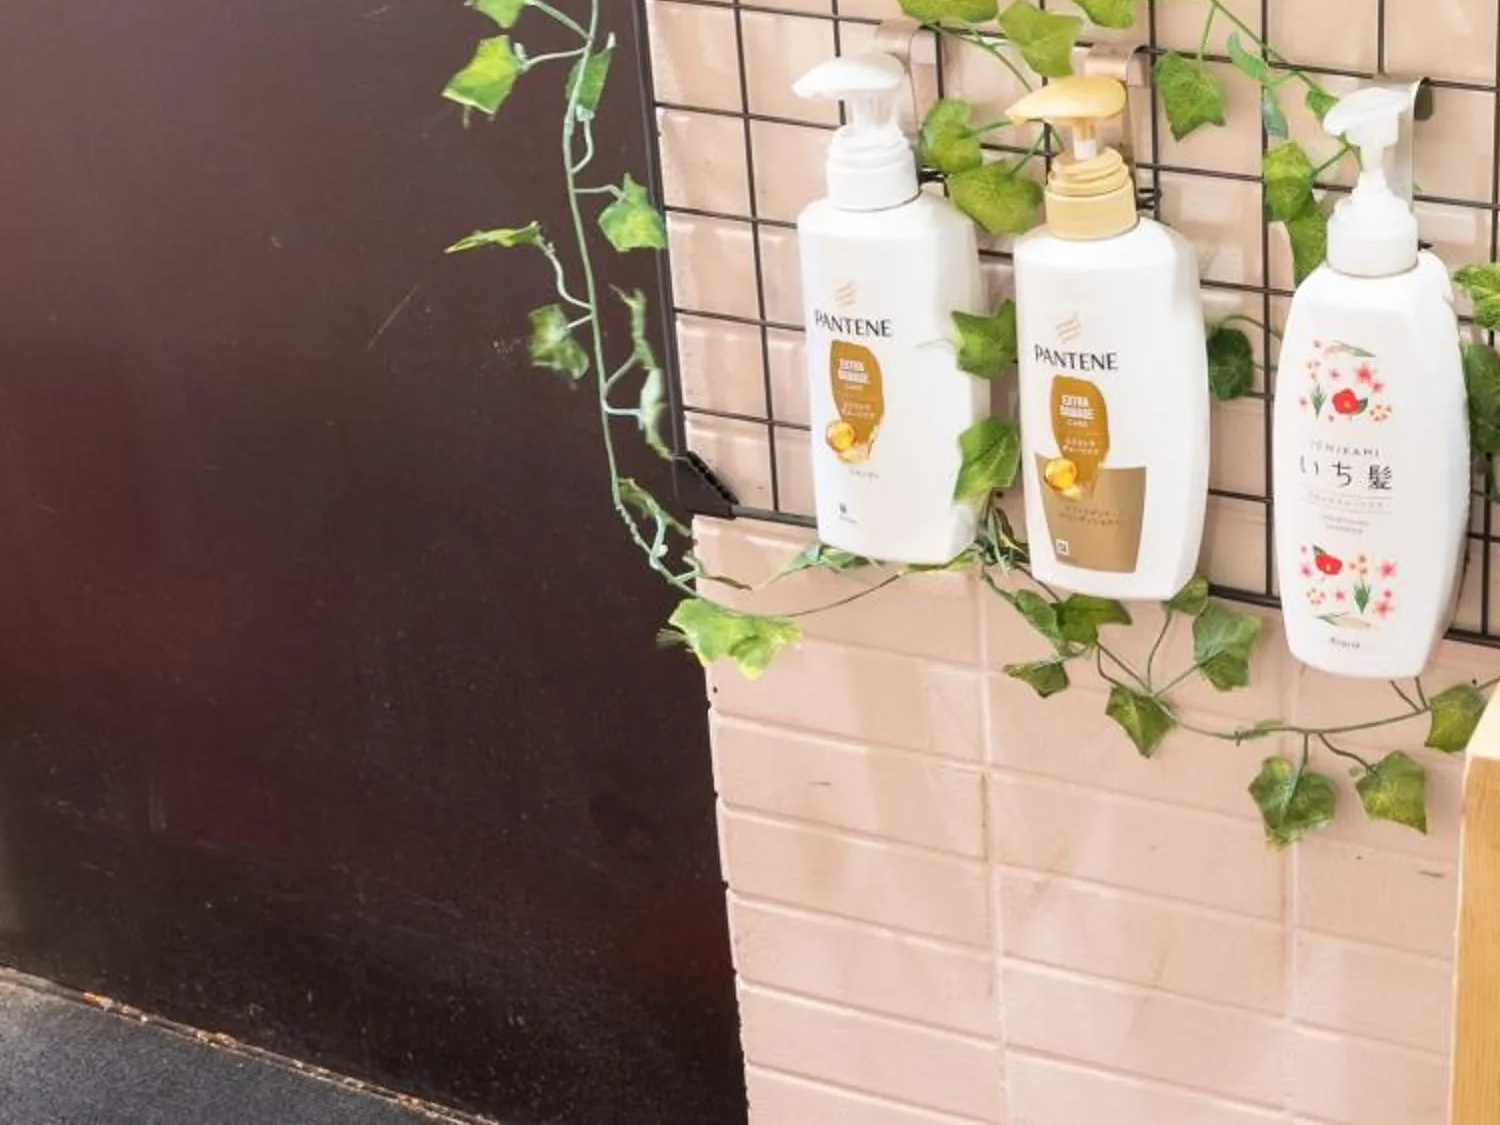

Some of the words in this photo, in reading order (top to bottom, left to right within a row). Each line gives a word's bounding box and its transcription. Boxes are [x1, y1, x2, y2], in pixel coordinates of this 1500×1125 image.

[814, 309, 895, 338] PANTENE
[1034, 344, 1119, 371] PANTENE
[1299, 453, 1394, 491] いち髪
